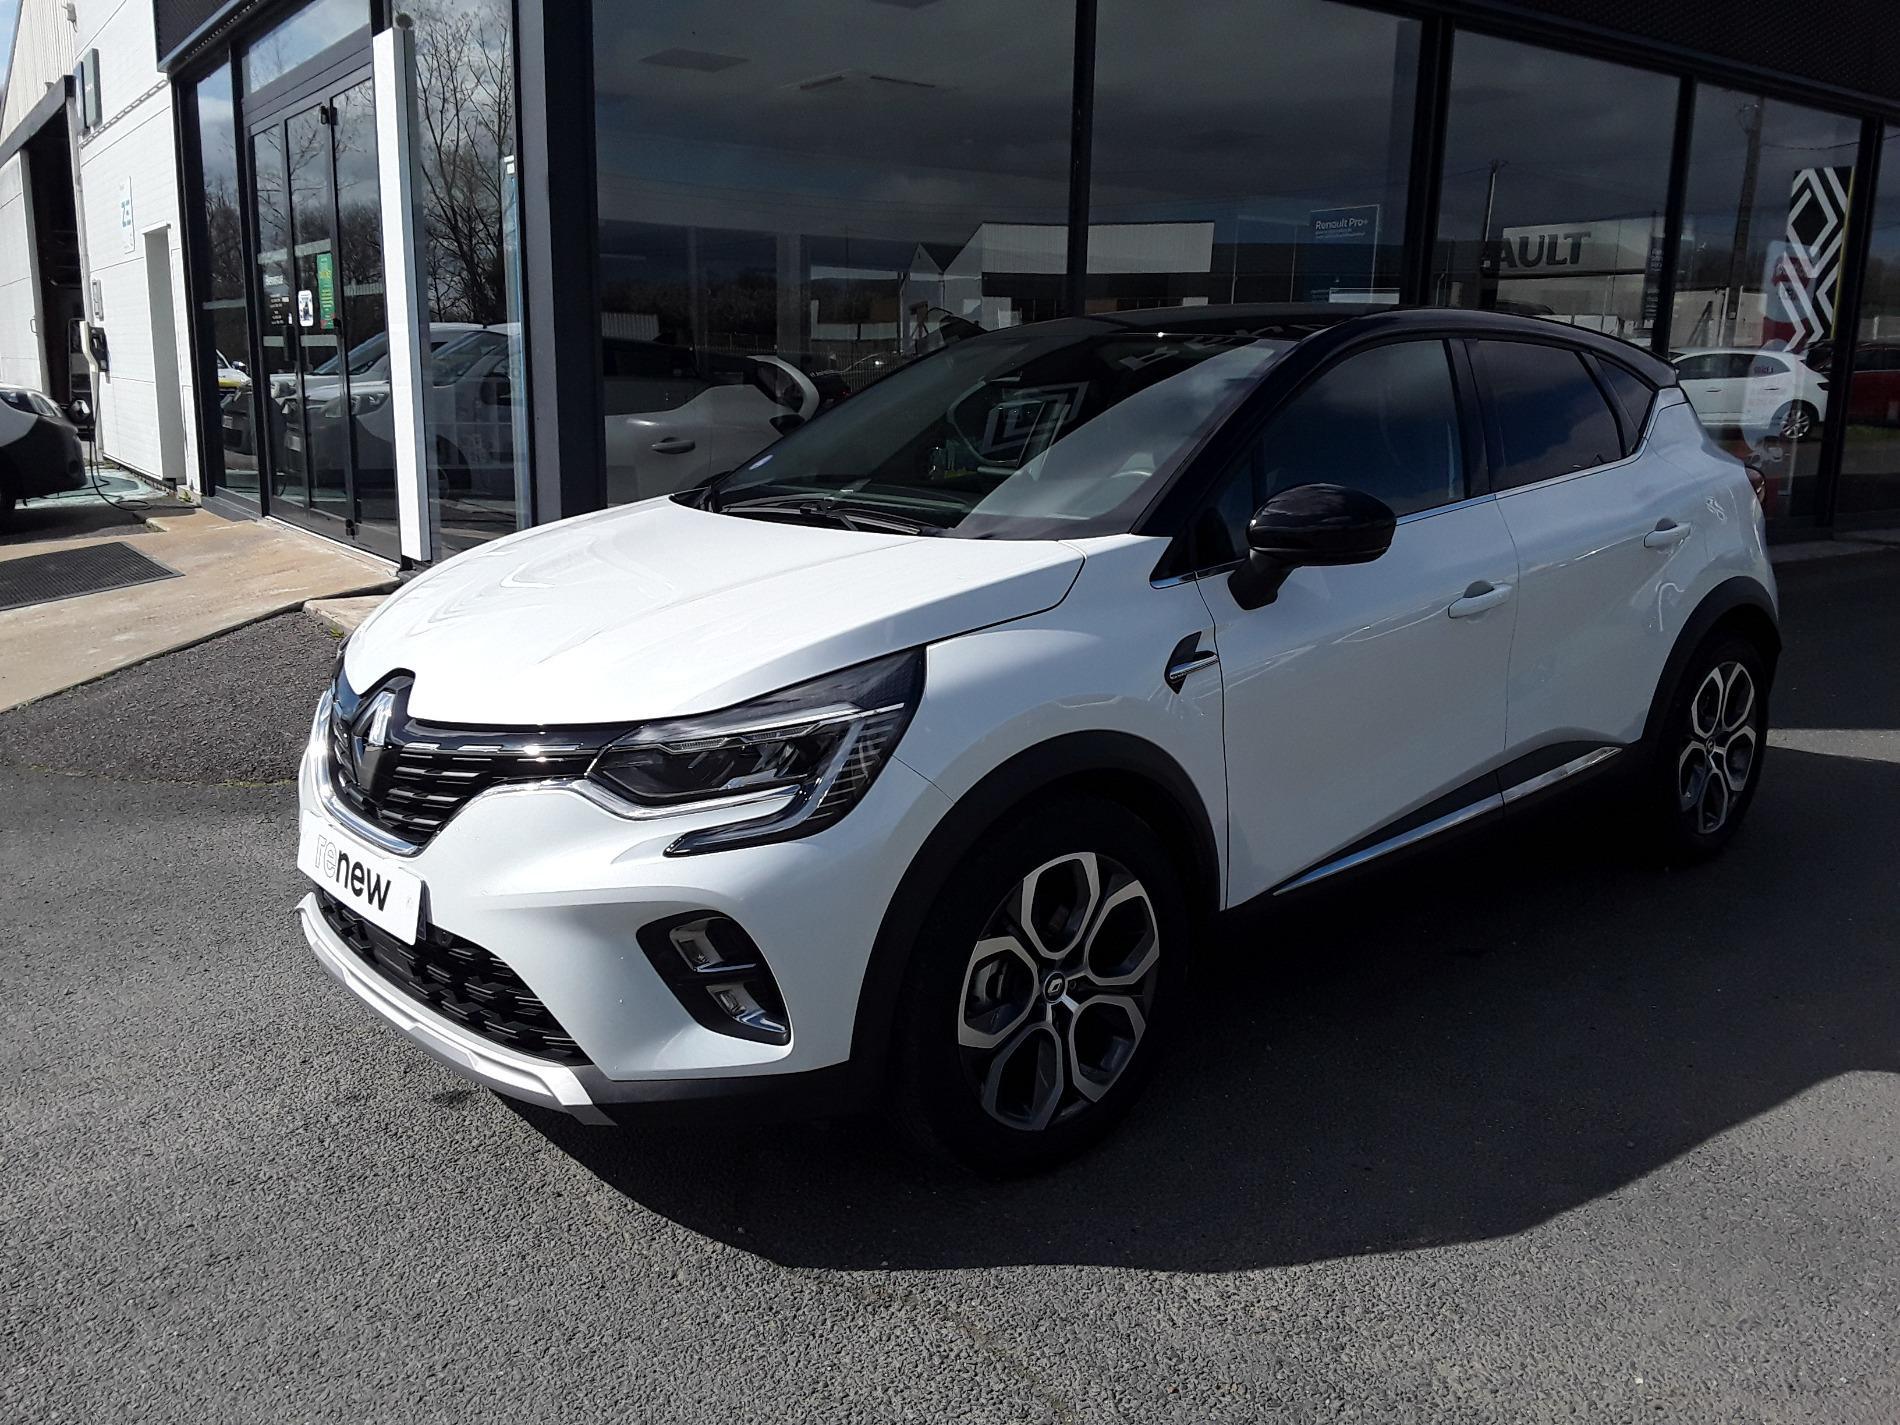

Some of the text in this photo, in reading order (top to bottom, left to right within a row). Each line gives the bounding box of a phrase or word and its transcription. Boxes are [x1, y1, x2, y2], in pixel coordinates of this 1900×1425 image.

[1315, 217, 1369, 231] Renault Pro+
[315, 834, 392, 912] renew
